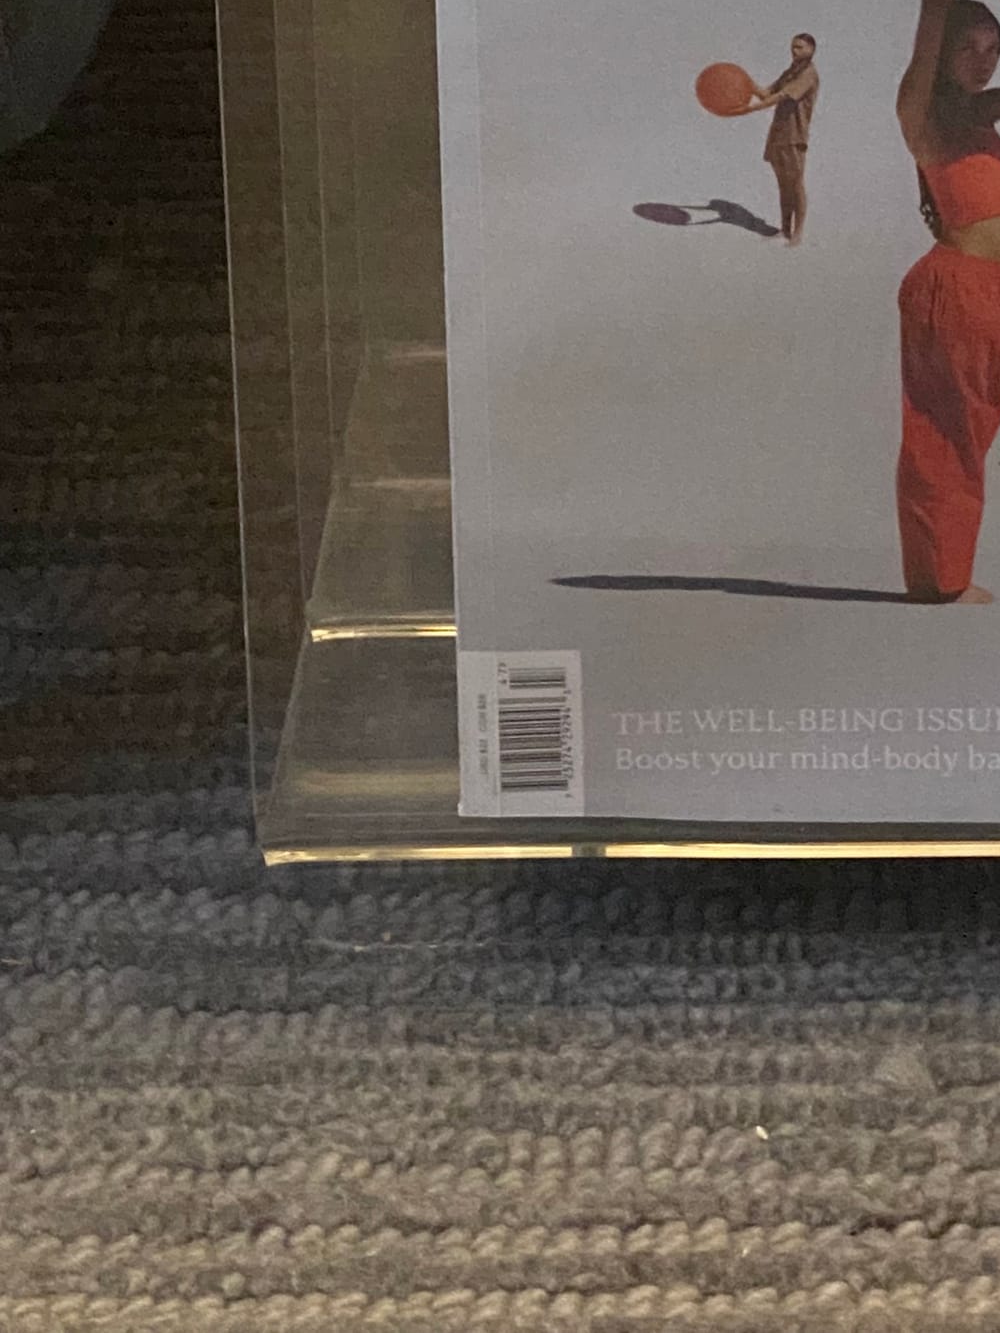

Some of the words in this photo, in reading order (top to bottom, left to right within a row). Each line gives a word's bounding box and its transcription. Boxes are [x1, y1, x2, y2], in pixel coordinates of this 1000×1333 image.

[612, 710, 684, 735] THE
[692, 708, 903, 733] WELL-BEING
[615, 747, 702, 770] Boost
[709, 750, 783, 776] your
[790, 744, 958, 776] mind-body
